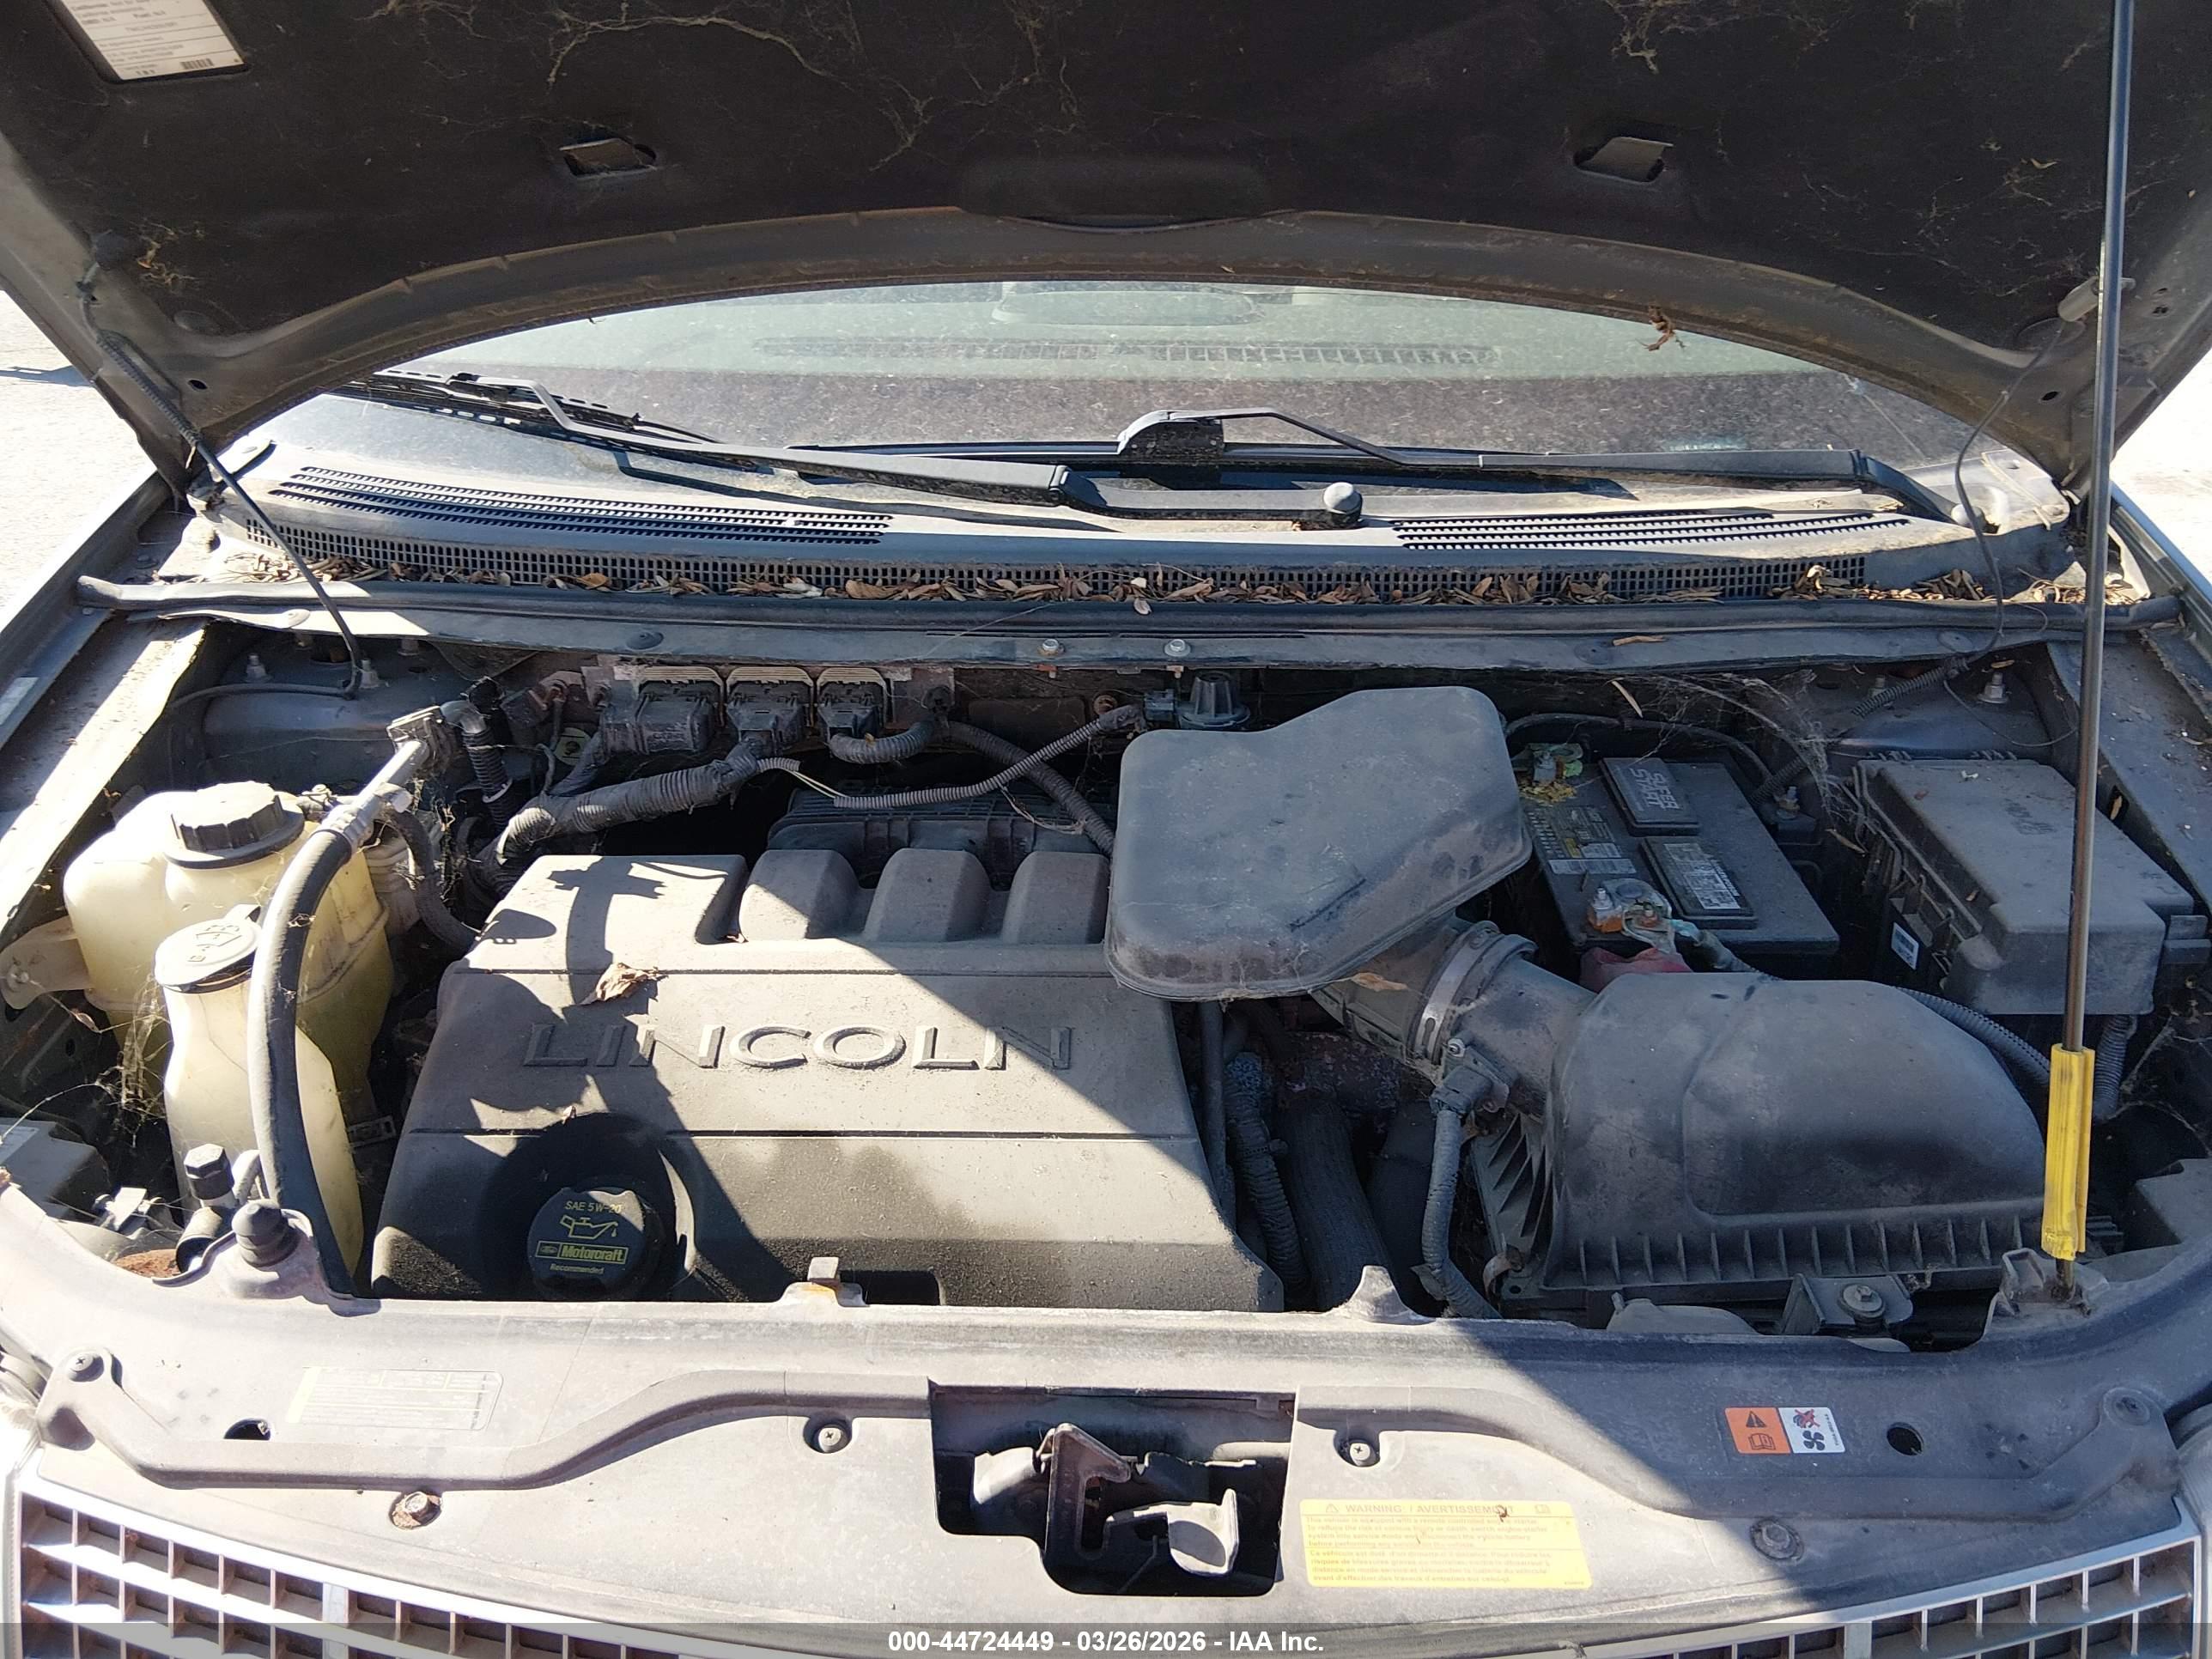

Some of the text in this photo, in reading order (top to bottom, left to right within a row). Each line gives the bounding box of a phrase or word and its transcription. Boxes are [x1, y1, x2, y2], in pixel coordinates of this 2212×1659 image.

[523, 1023, 1073, 1071] LINCOLN
[564, 1200, 624, 1213] SAE 5W-20
[562, 1245, 623, 1261] Motorcraft
[550, 1264, 604, 1274] Recommended
[1346, 1504, 1402, 1513] WARNING
[1417, 1504, 1514, 1514] AVERTISSEMT
